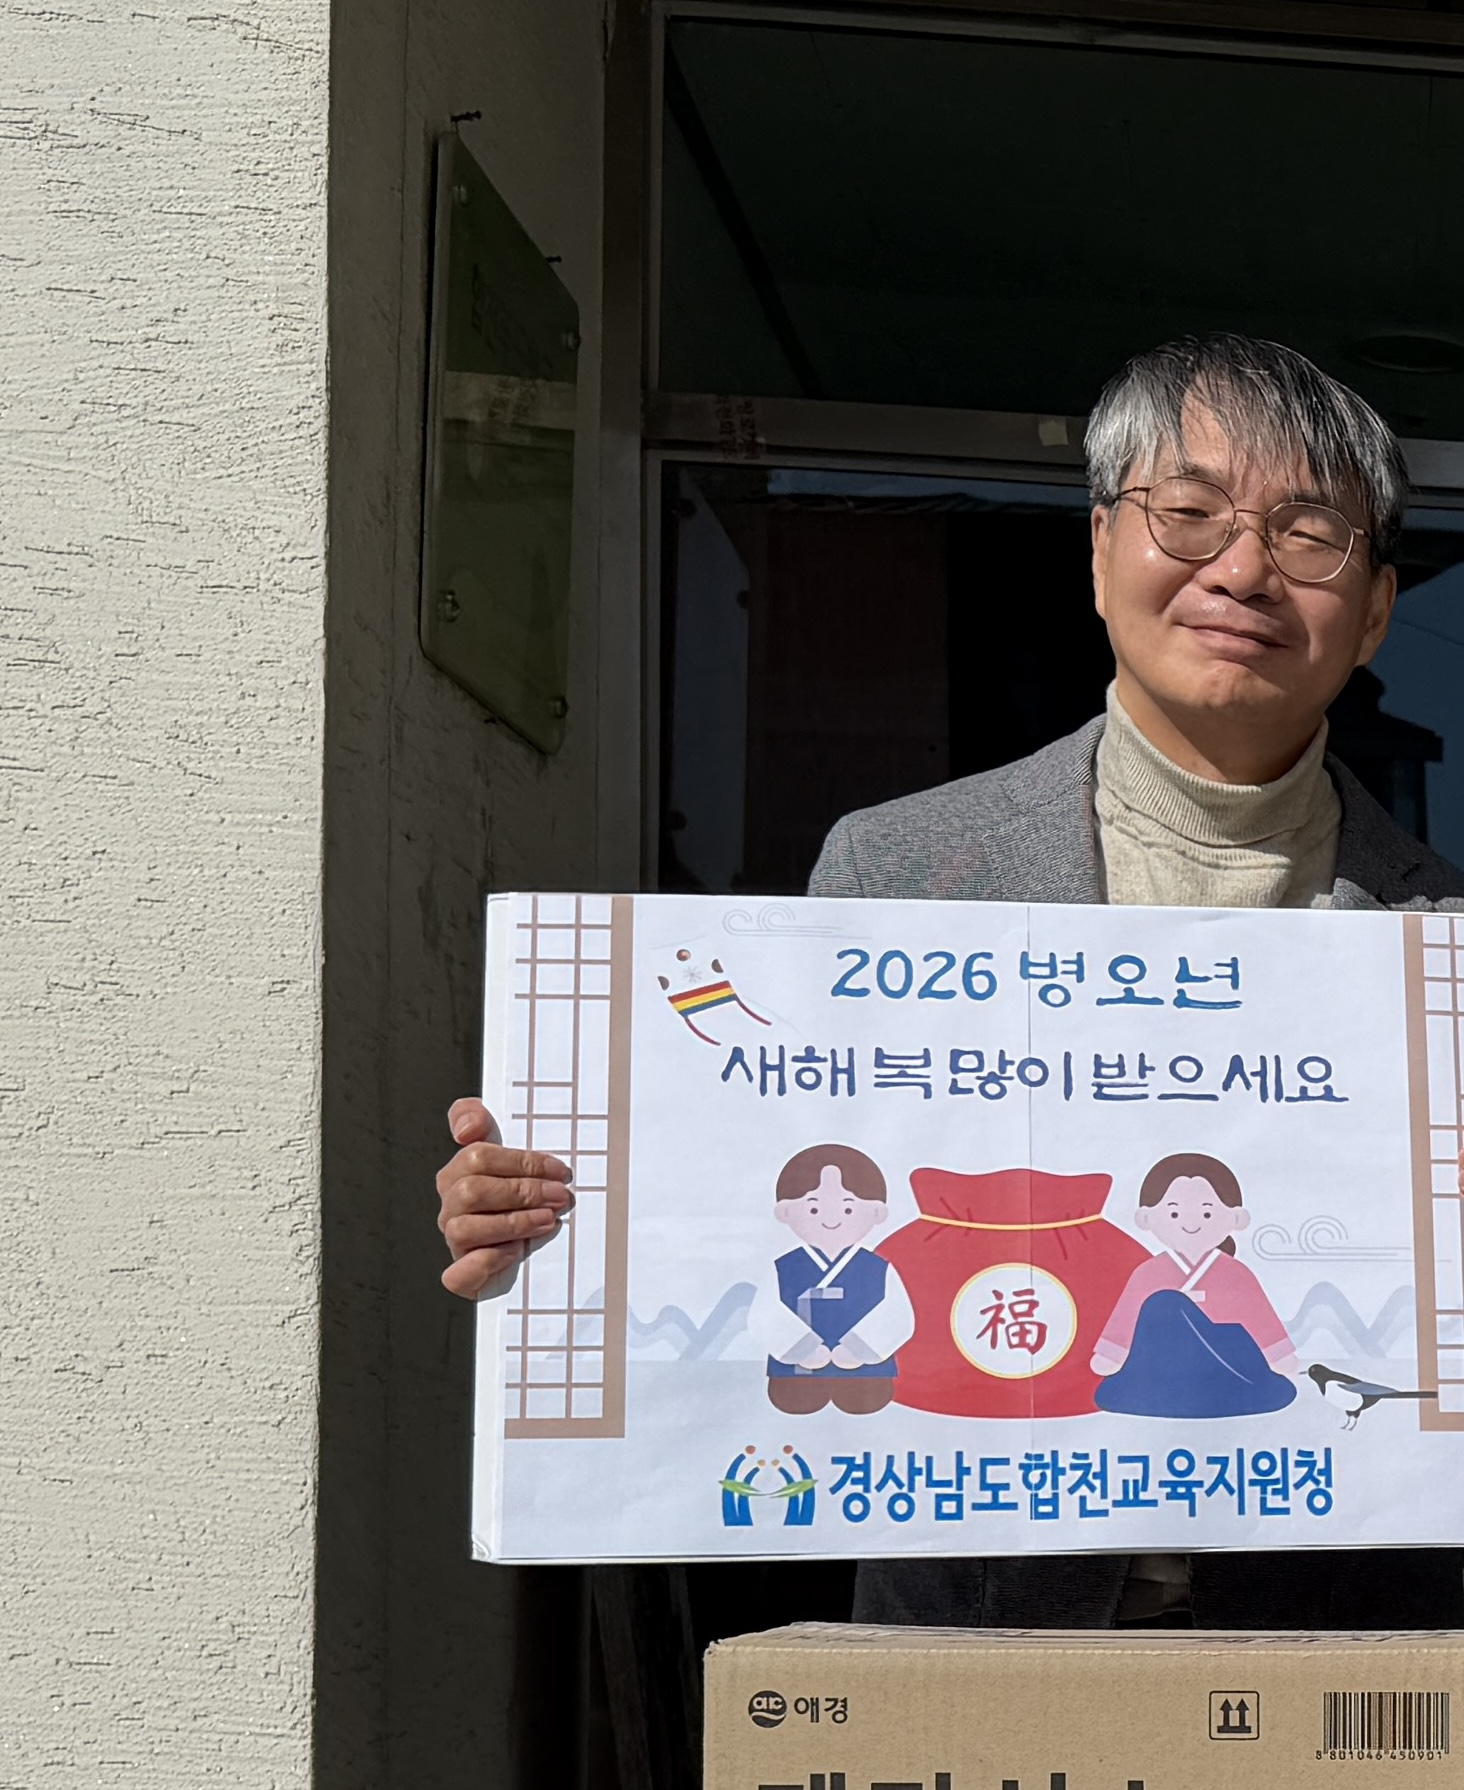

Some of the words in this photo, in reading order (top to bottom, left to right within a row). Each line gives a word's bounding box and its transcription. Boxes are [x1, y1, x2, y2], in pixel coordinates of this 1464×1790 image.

[830, 947, 997, 1002] 2026
[1017, 949, 1242, 1011] 병오년
[721, 1043, 857, 1100] 새해
[871, 1046, 934, 1099] 복
[947, 1045, 1073, 1102] 많이
[1091, 1047, 1350, 1105] 받으세요
[976, 1288, 1048, 1358] 福
[827, 1446, 1336, 1520] 경상남도합천교육지원청
[793, 1695, 850, 1725] 애경
